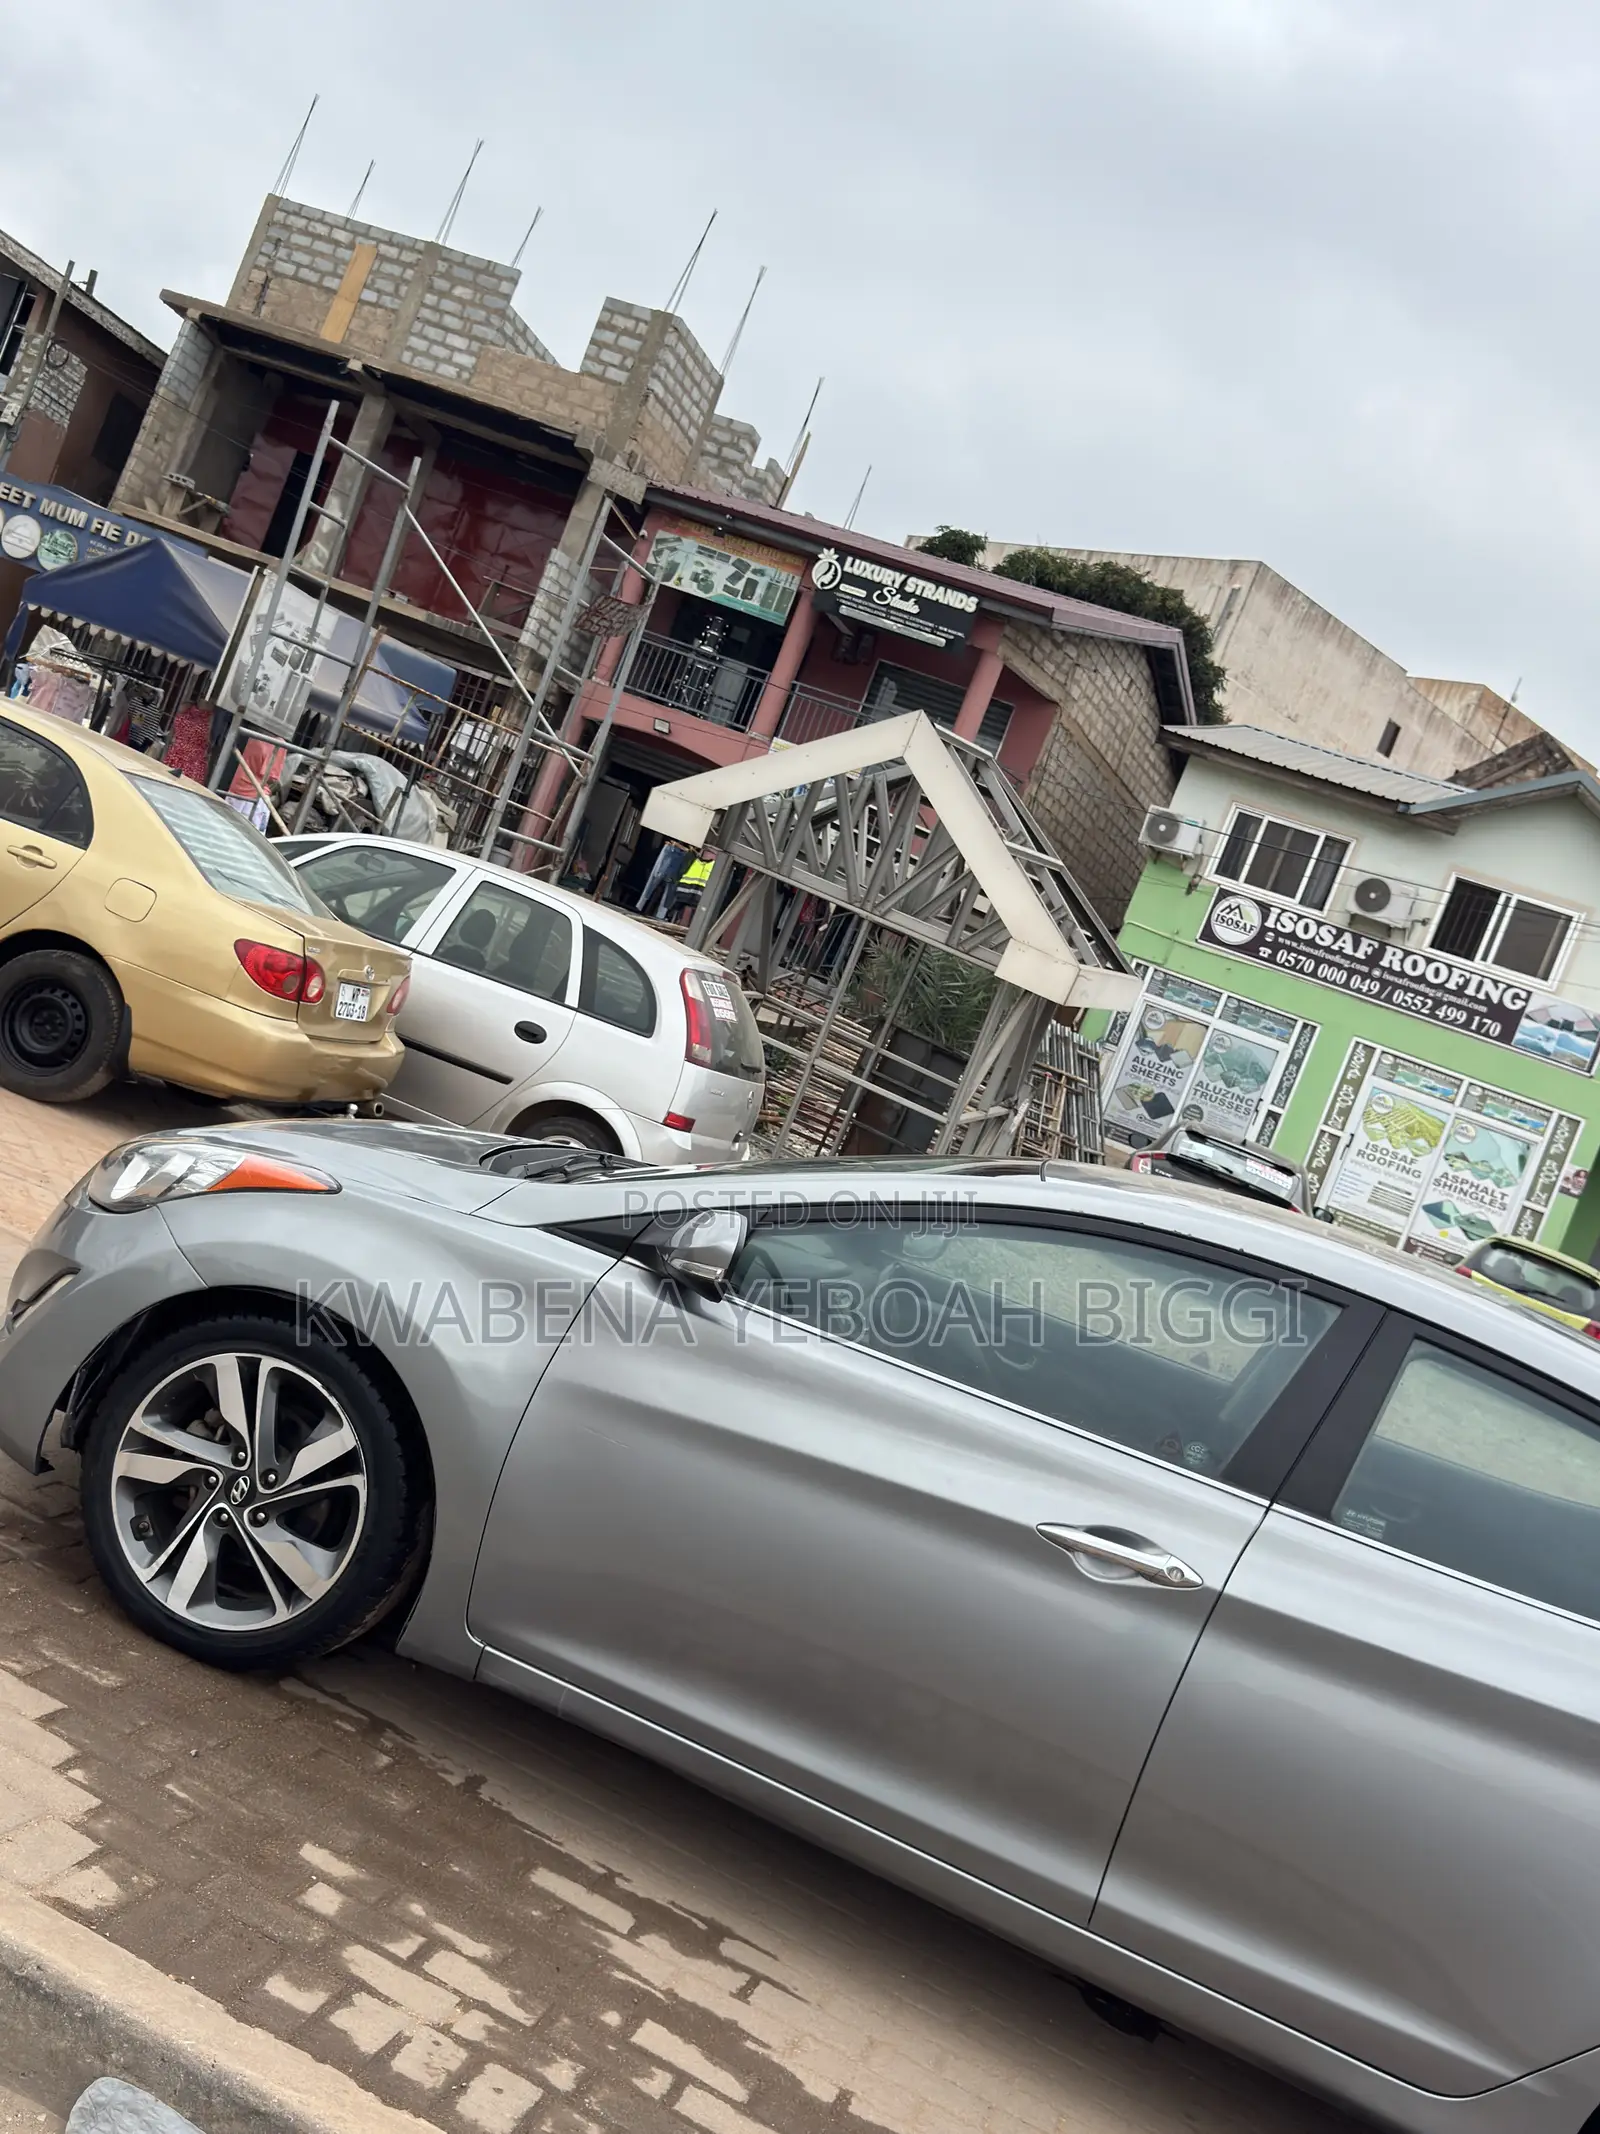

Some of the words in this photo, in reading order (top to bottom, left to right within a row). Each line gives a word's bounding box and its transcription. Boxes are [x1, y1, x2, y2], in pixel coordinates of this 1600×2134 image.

[39, 498, 89, 529] MUM
[90, 517, 123, 543] FIE
[843, 556, 907, 590] LUXURY
[904, 576, 979, 613] STRANDS
[872, 587, 920, 614] Studio
[1214, 913, 1256, 935] ISOSAF
[1264, 907, 1379, 960] ISOSAF
[1379, 946, 1528, 1010] ROOFING
[1278, 936, 1369, 973] www.isosafroofing.com
[1276, 949, 1315, 974] 0570
[1317, 963, 1347, 985] 000
[1350, 975, 1380, 995] 049
[1380, 986, 1392, 999] /
[1392, 988, 1433, 1014] 0552
[1435, 1005, 1467, 1025] 499
[1470, 1015, 1501, 1037] 170
[1130, 1063, 1177, 1087] SHEETS
[1132, 1056, 1184, 1079] ALUZINC
[1192, 1088, 1252, 1116] TRUSSES
[1195, 1081, 1256, 1107] ALUZINC
[1356, 1149, 1422, 1179] ROOFING
[1365, 1142, 1419, 1166] ISOSAF
[1432, 1178, 1508, 1211] SHINGLES
[1439, 1171, 1509, 1200] ASPHALT
